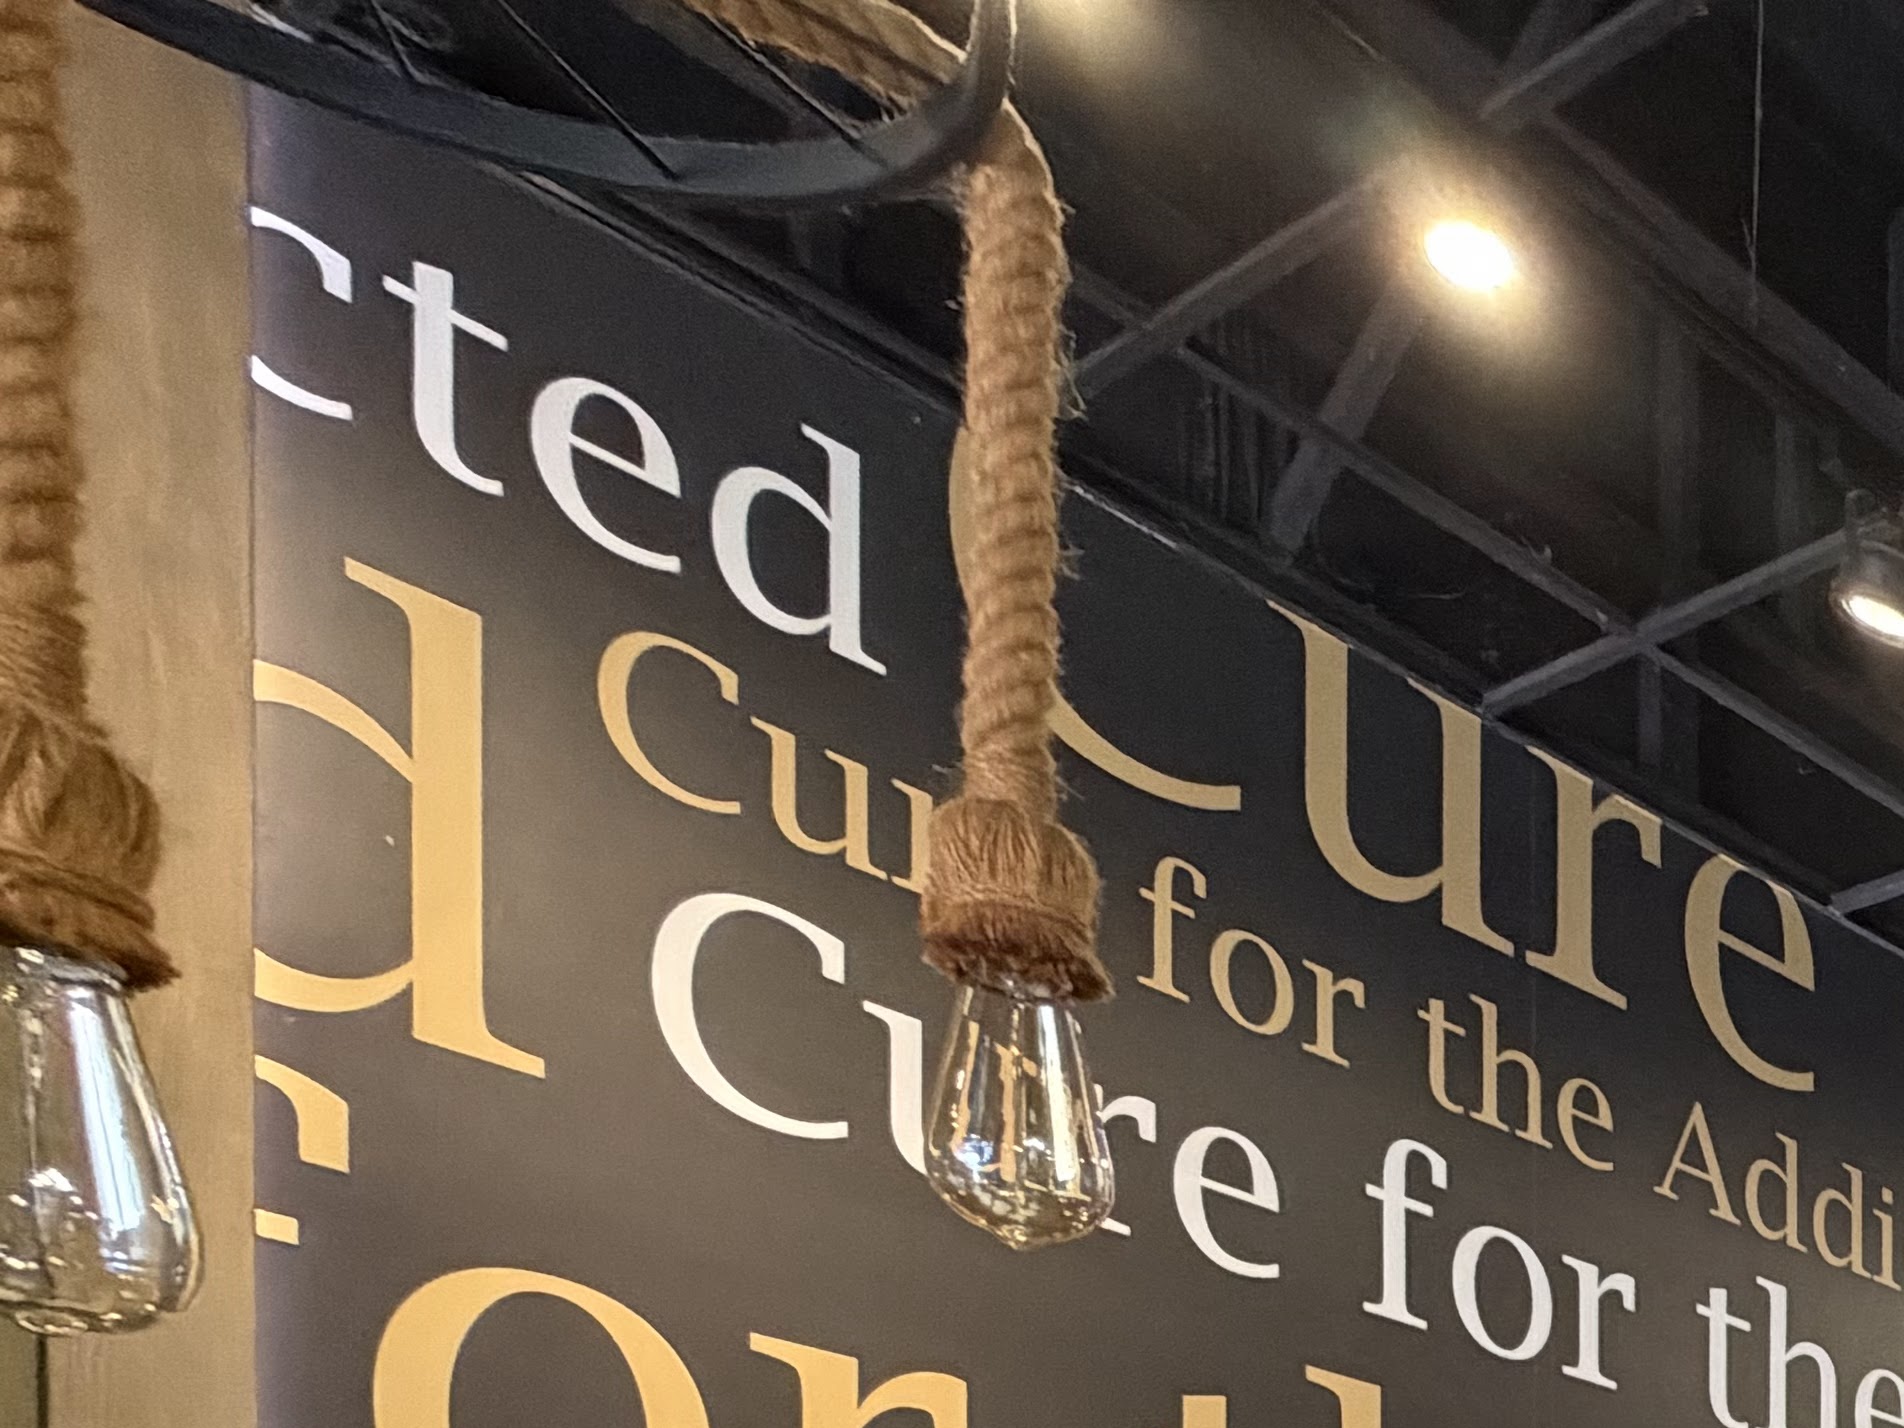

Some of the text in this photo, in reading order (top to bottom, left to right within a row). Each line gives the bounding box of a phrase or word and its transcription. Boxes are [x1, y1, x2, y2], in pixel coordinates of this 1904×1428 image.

[1137, 856, 1366, 1068] for
[1417, 994, 1613, 1172] the
[1363, 1140, 1635, 1390] for
